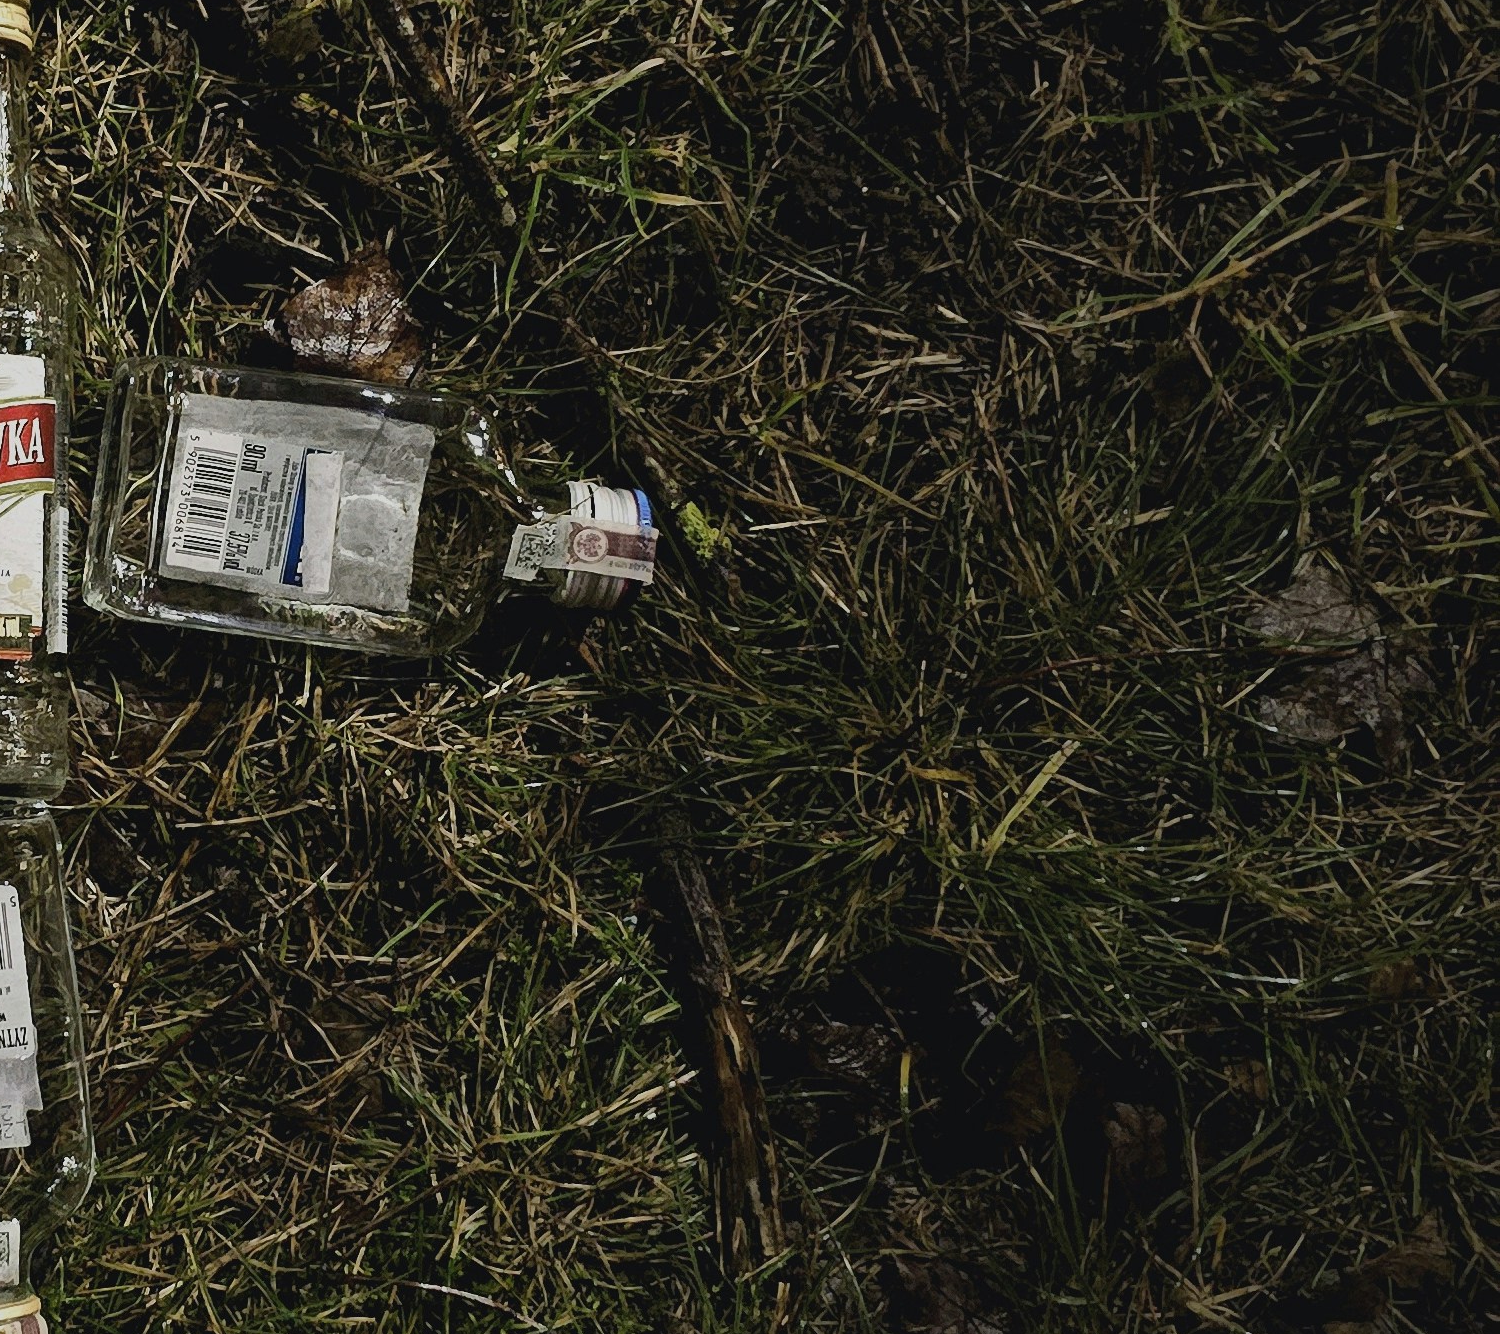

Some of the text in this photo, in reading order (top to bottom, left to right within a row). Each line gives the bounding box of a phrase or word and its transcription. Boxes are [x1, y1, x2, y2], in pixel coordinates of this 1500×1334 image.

[244, 443, 267, 459] 90
[180, 450, 198, 497] 902573
[241, 458, 263, 473] ml
[172, 503, 189, 548] 006814
[9, 896, 17, 908] 5
